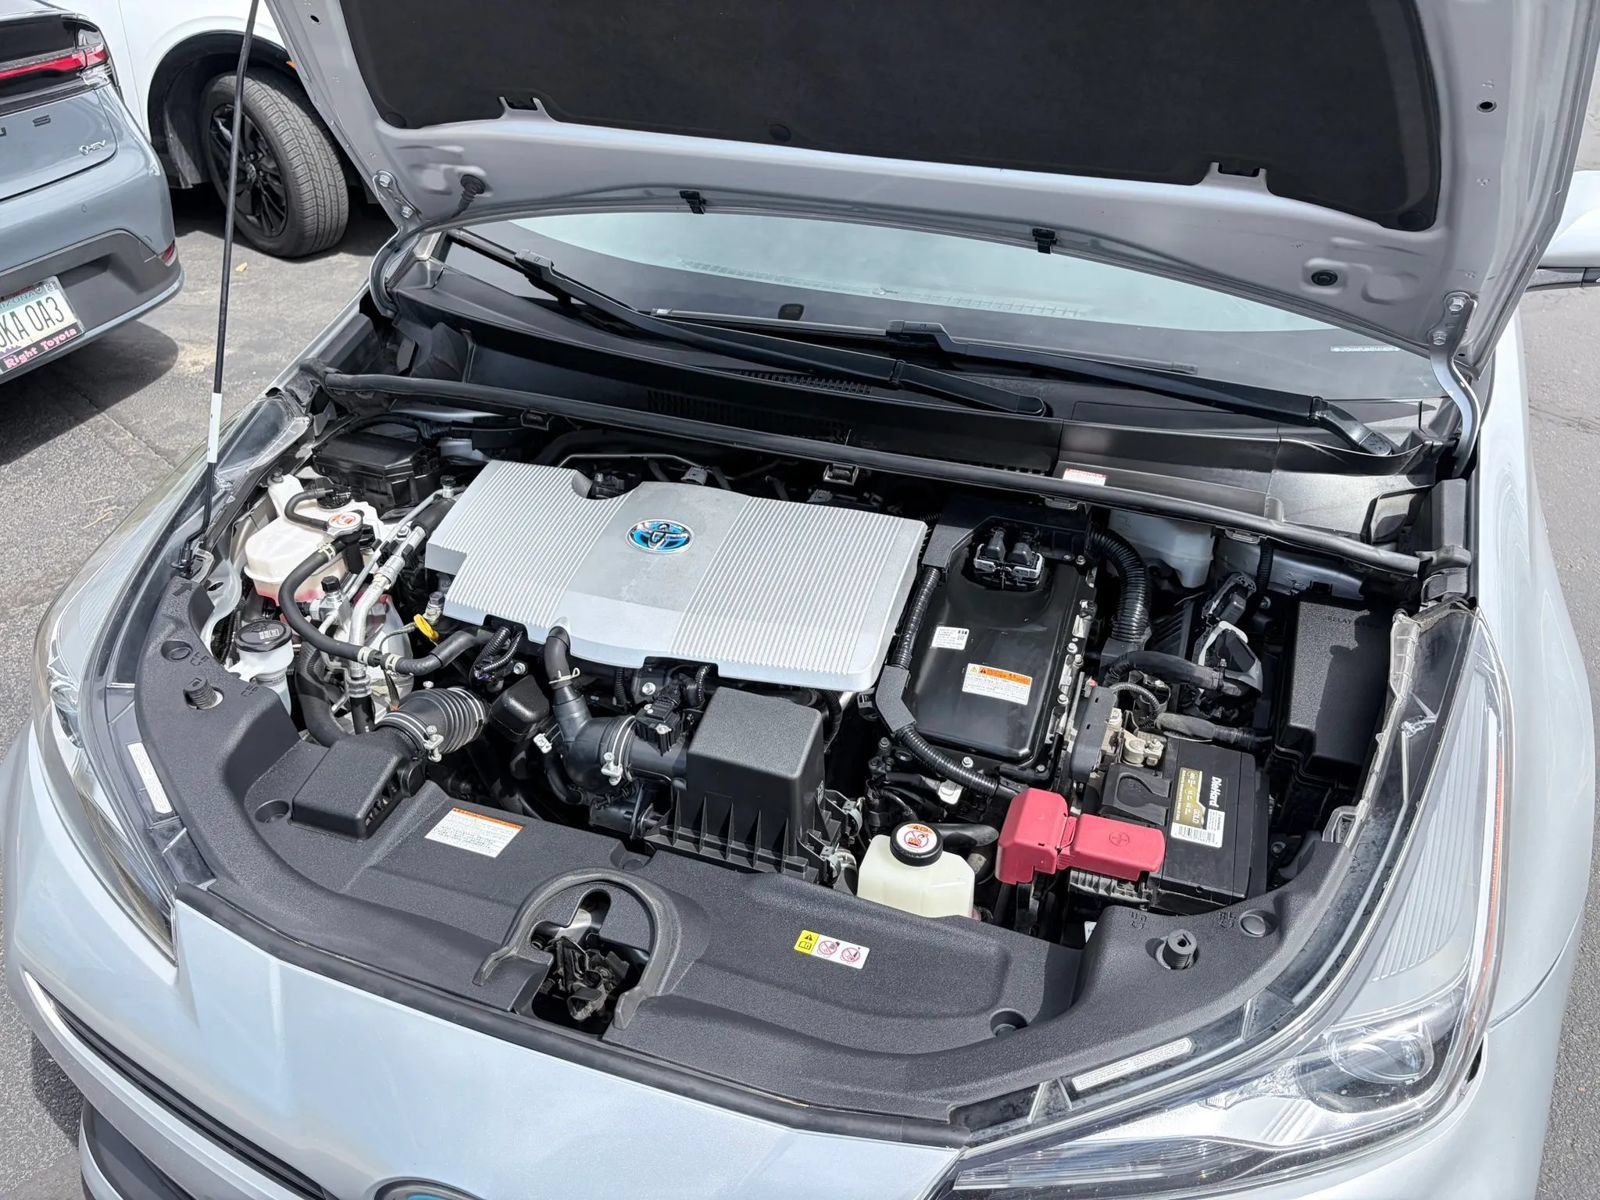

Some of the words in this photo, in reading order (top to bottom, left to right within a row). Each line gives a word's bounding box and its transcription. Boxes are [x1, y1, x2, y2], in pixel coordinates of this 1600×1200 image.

[4, 346, 38, 369] Right
[40, 328, 77, 352] Toyota
[1209, 776, 1223, 808] DieHard
